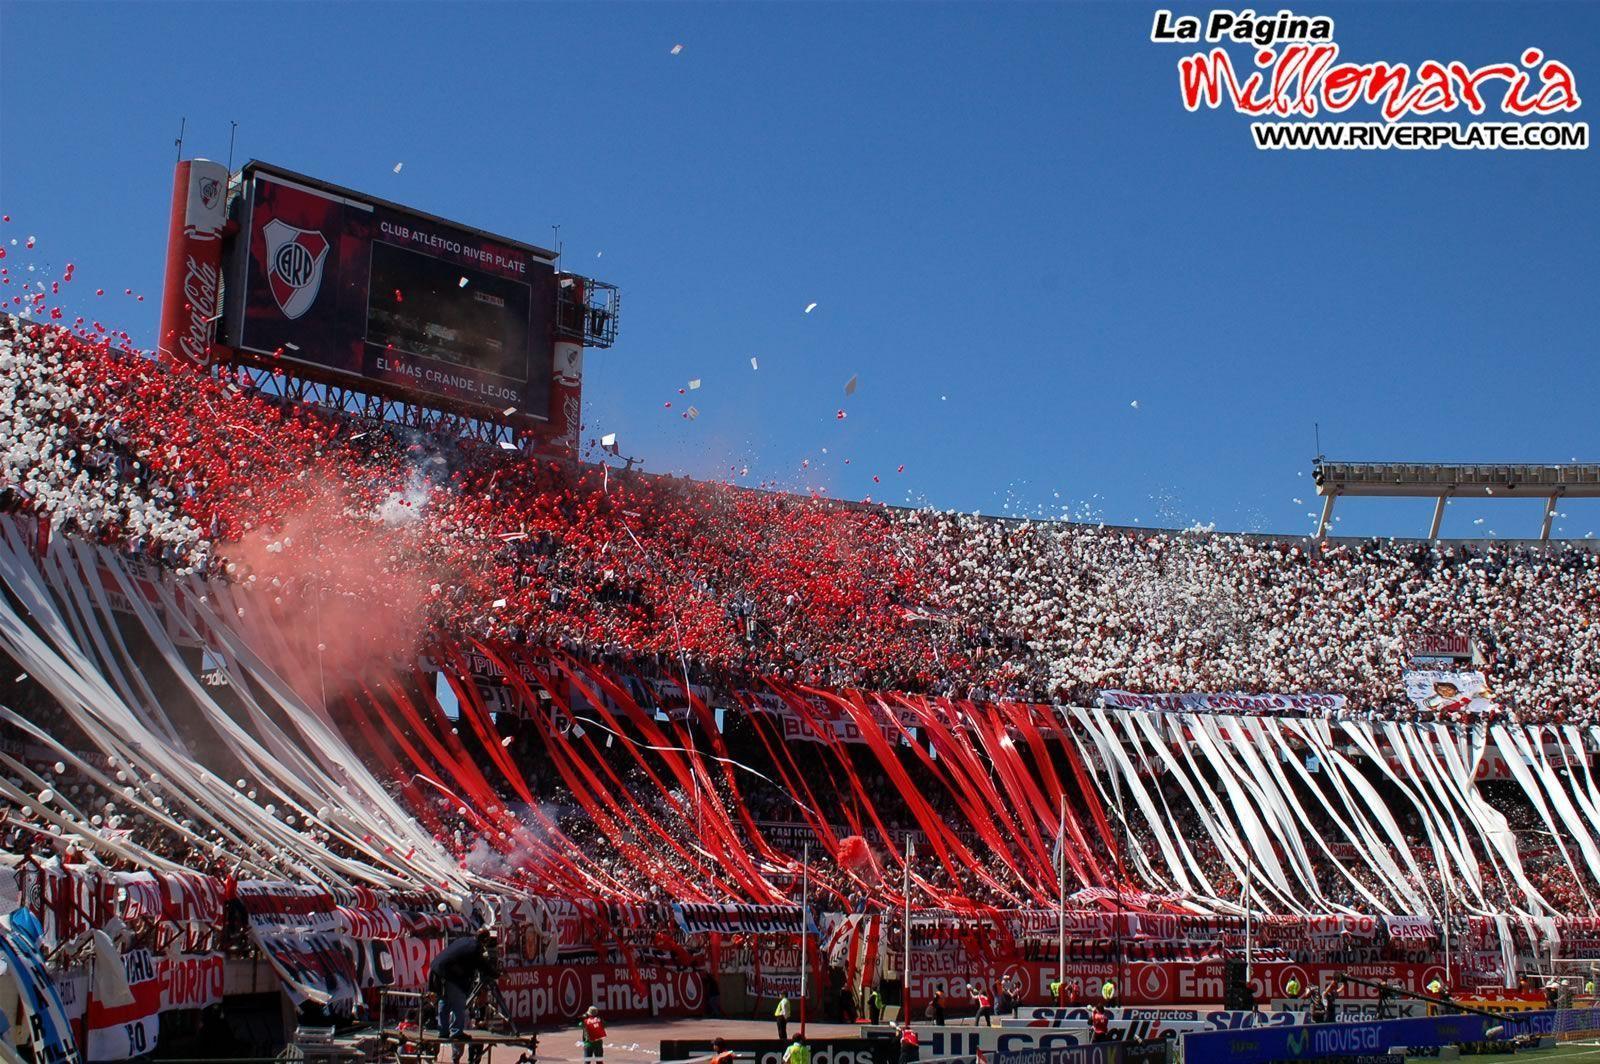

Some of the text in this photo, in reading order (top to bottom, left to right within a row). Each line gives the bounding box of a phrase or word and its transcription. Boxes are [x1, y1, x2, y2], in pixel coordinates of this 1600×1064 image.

[381, 222, 526, 273] CLUB ATLÉTICO RIVER PLATE
[376, 357, 392, 372] EL
[396, 364, 422, 378] MAS
[480, 384, 521, 402] LEJOS.
[680, 903, 810, 933] HURLINGHAM
[1389, 924, 1436, 938] GARIN
[886, 950, 957, 973] TEPERLEY
[1066, 963, 1113, 975] PINTURAS
[1347, 965, 1396, 976] PINTURAS
[157, 955, 225, 1006] FIORITO
[501, 975, 553, 1023] mapi
[1131, 1009, 1193, 1021] Productos
[1315, 1025, 1383, 1053] movistar
